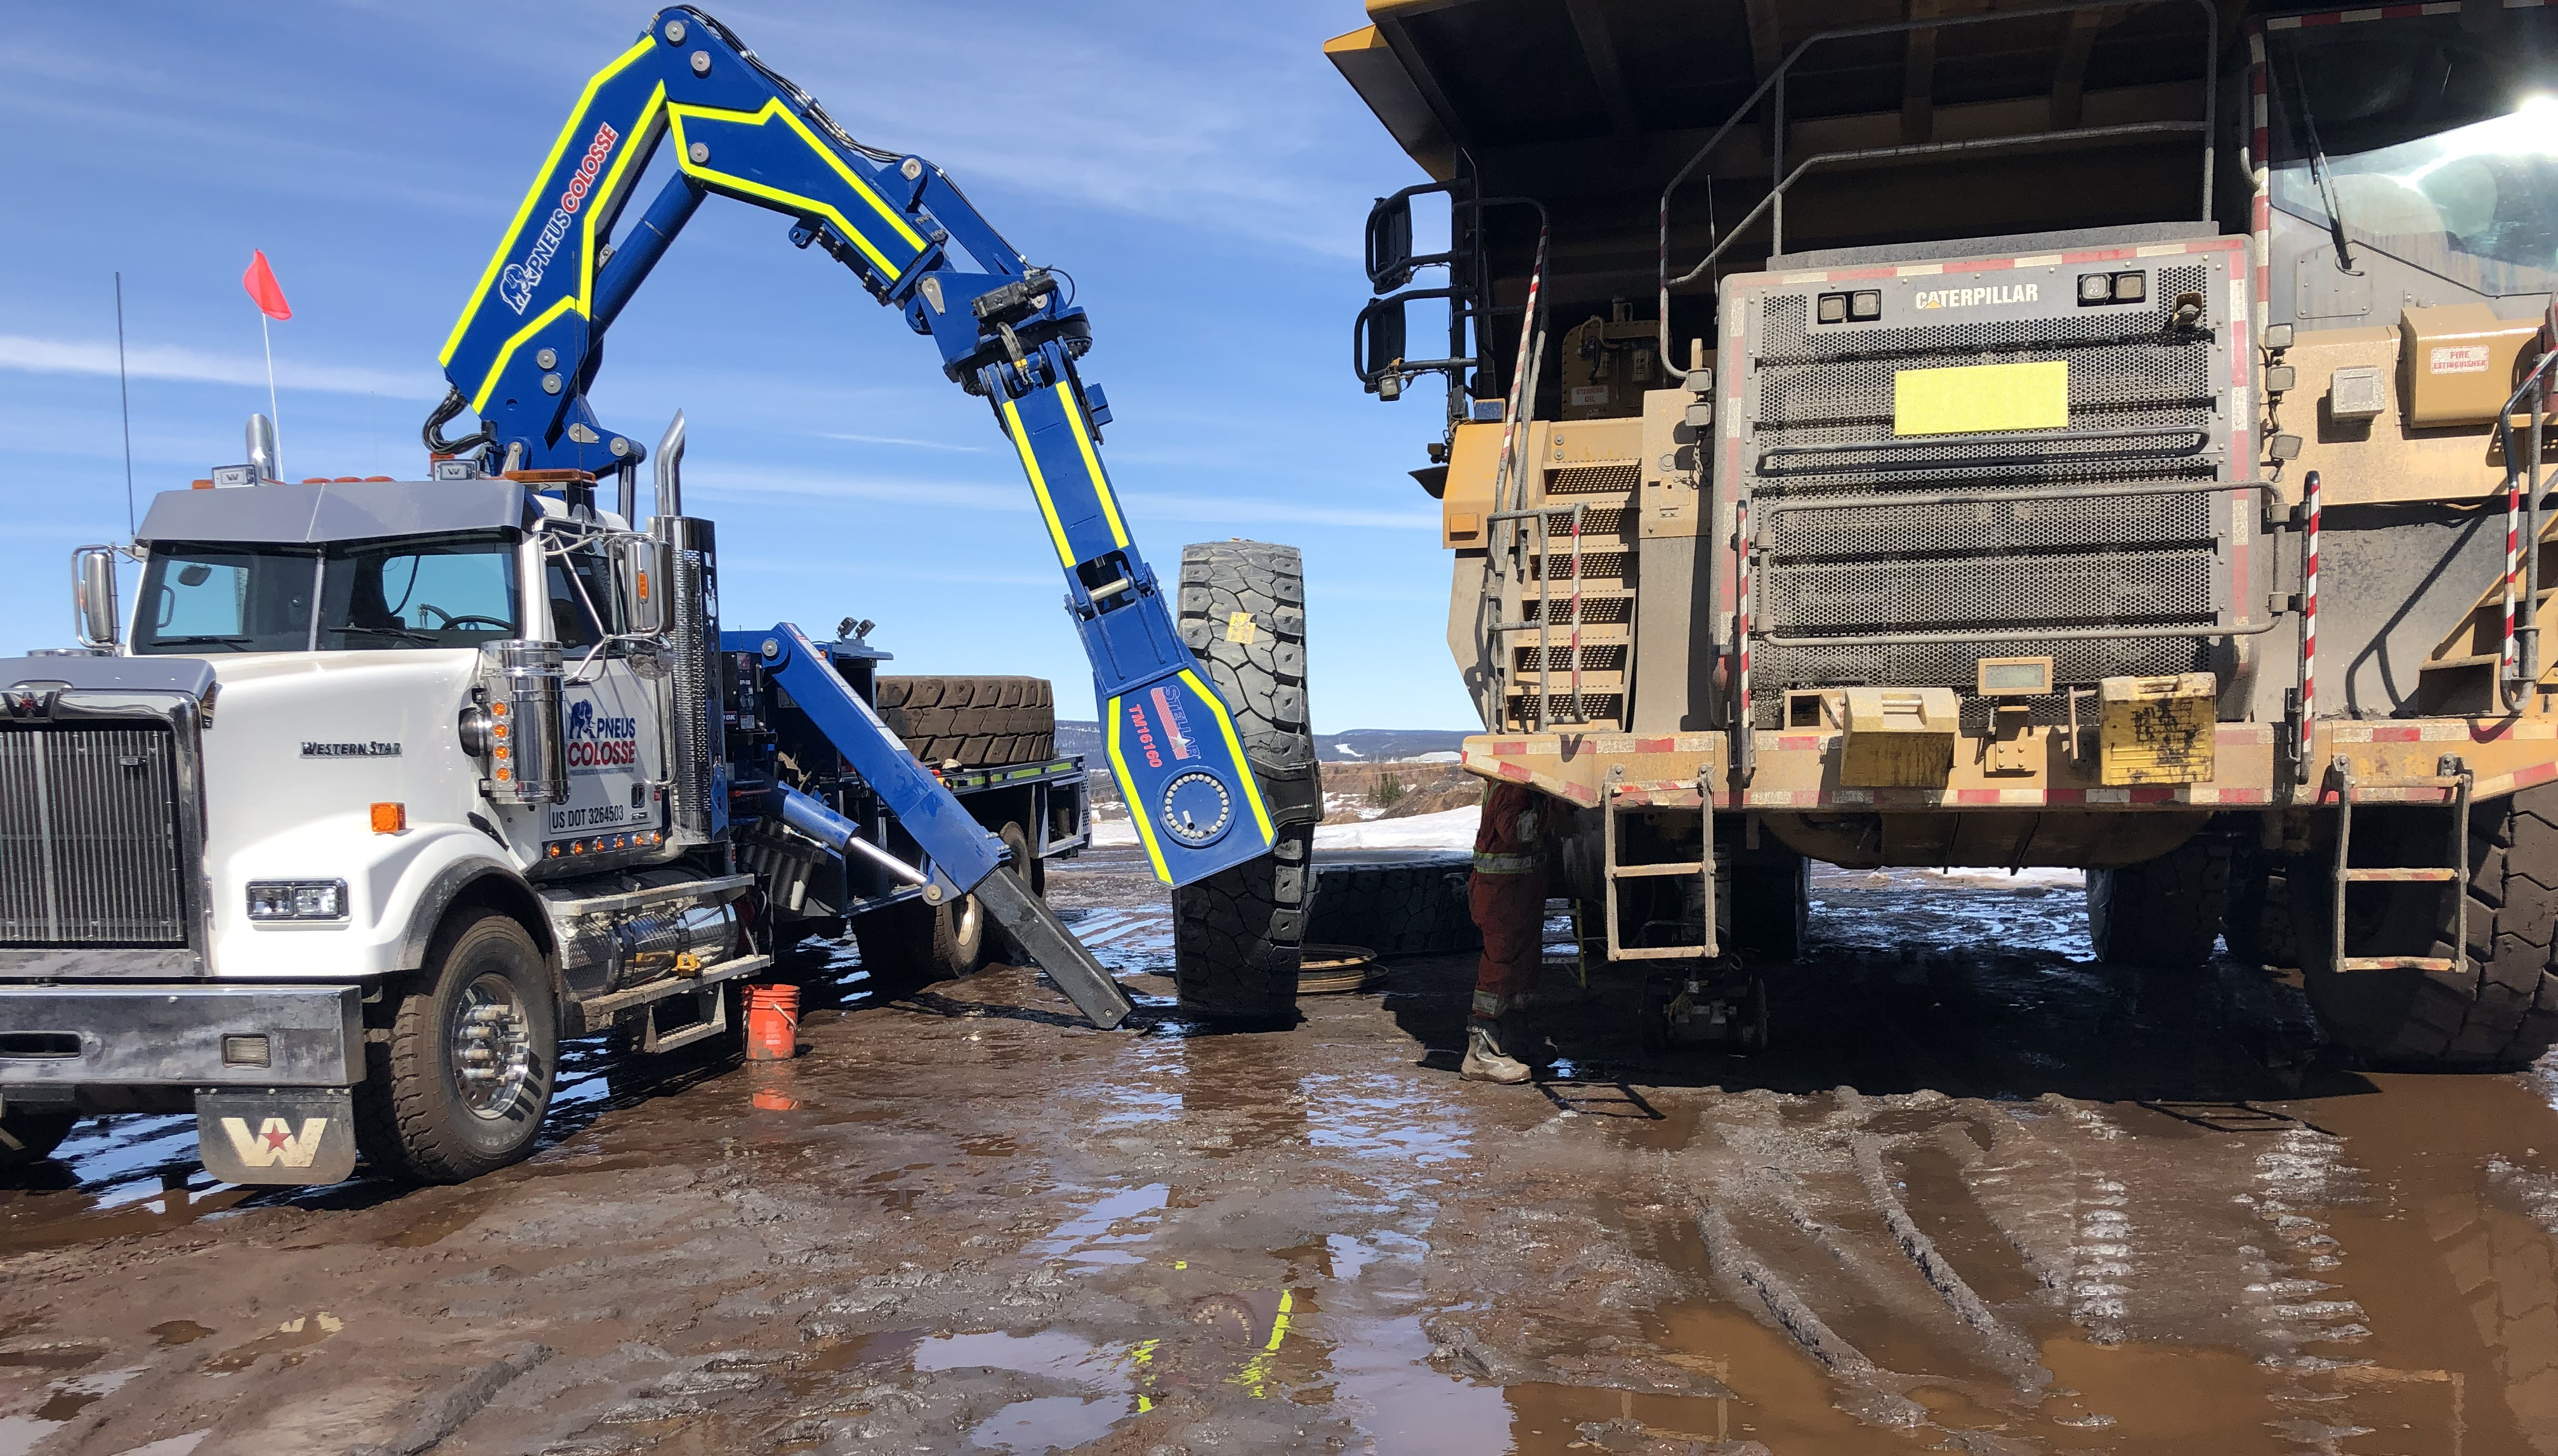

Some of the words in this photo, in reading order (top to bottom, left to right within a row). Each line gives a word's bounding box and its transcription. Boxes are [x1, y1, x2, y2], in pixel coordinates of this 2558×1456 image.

[525, 208, 572, 275] PNEUS
[561, 122, 619, 213] COLOSSE
[1915, 284, 2038, 310] CATERPILLAR
[2434, 360, 2486, 369] EXTINGUISHER
[2450, 350, 2470, 359] FIRE
[597, 718, 636, 738] PNEUS
[1163, 685, 1200, 758] STELLAR
[300, 741, 367, 756] WESTERN
[369, 741, 403, 756] STAR
[1129, 704, 1163, 768] TM16160
[568, 741, 635, 766] COLOSSE
[552, 810, 565, 829] US
[568, 808, 587, 827] DOT
[589, 804, 624, 824] 3264503
